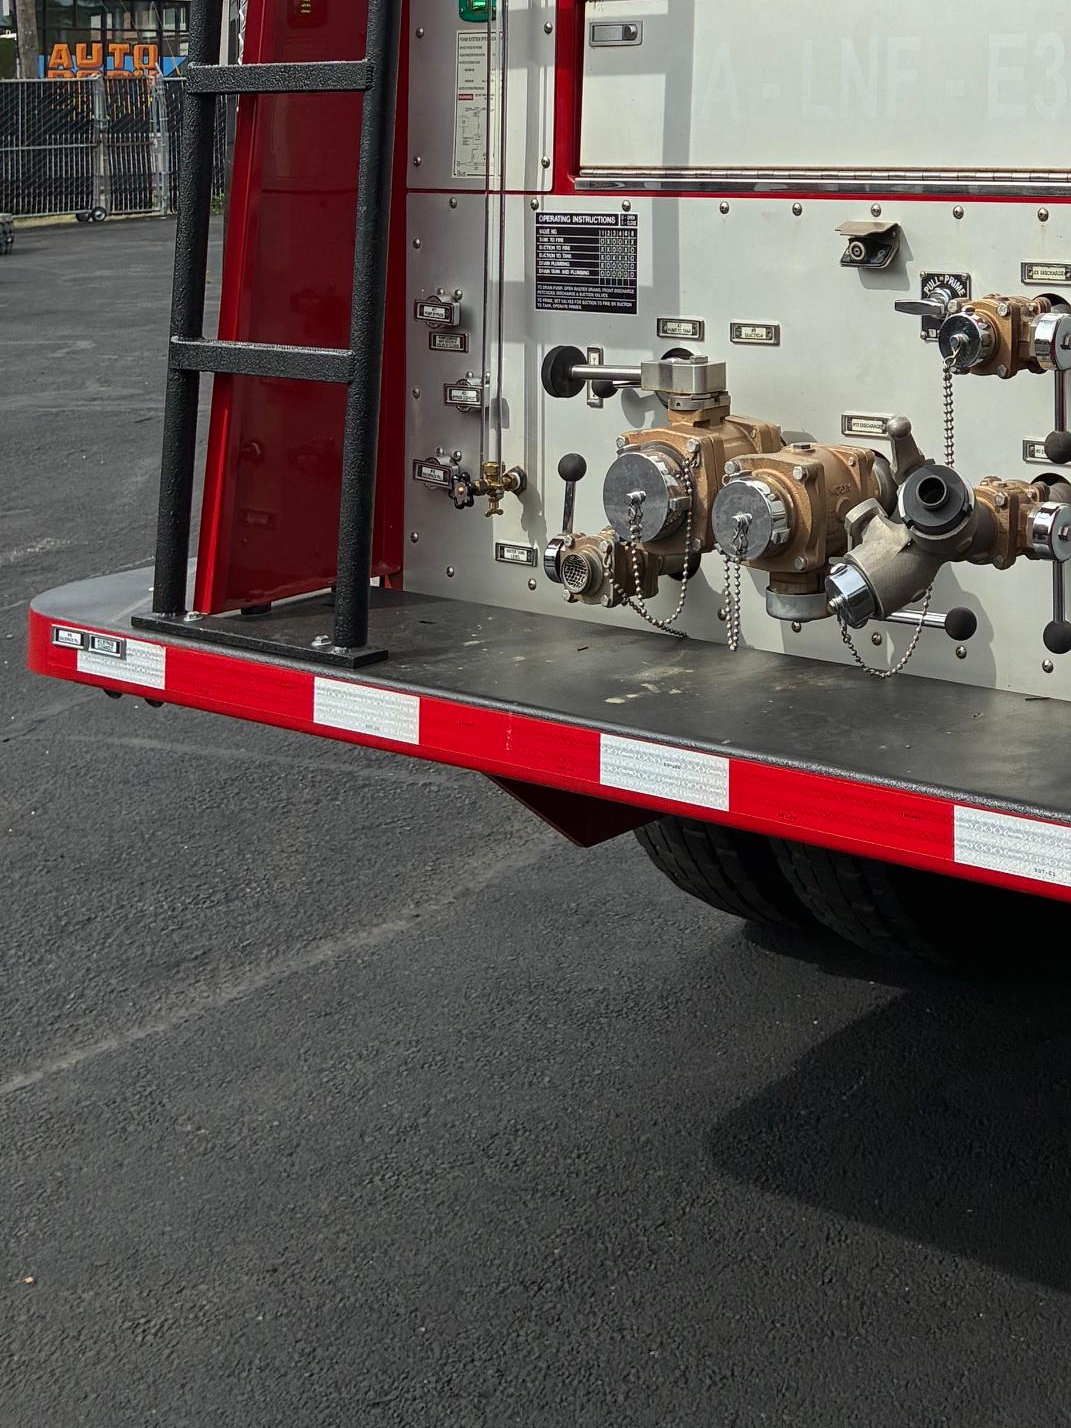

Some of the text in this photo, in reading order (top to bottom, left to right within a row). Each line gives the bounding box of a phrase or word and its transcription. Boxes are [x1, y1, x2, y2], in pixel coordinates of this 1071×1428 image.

[48, 43, 158, 70] AUTO
[539, 215, 616, 224] OPERATING INSTRUCTIONS
[924, 275, 966, 296] PULL PRIME
